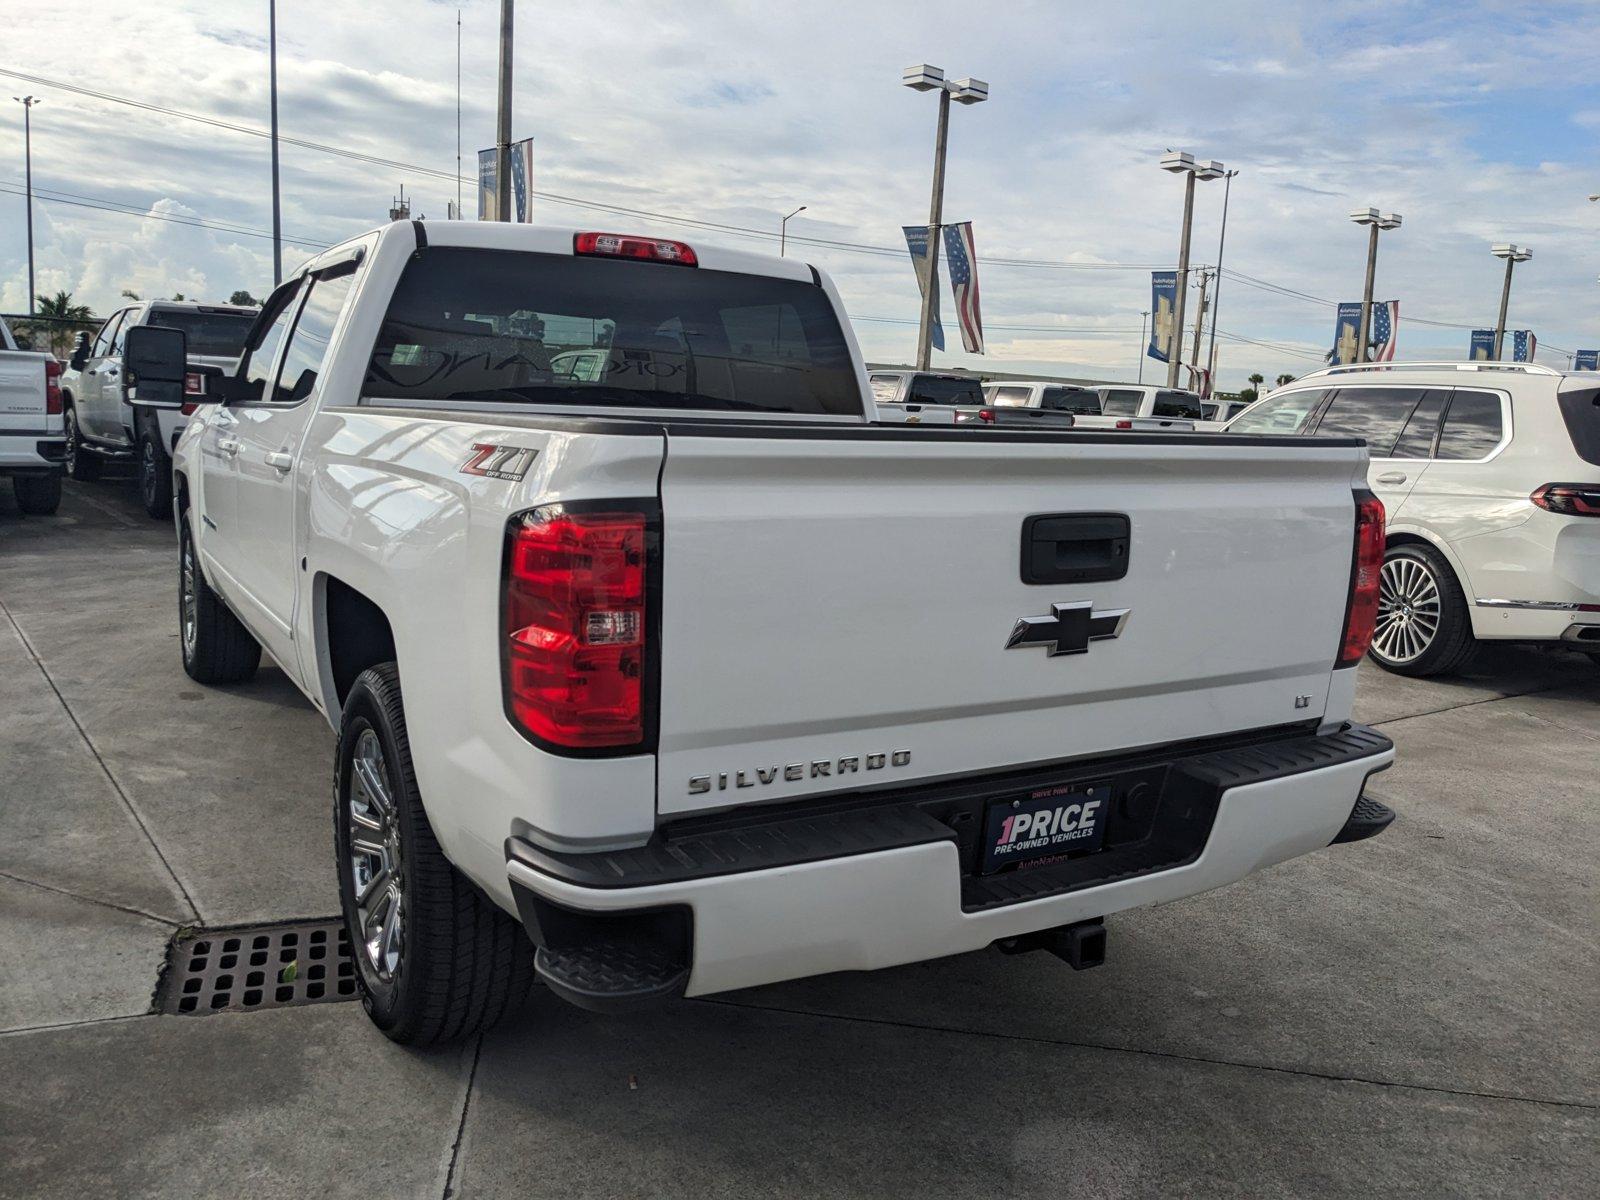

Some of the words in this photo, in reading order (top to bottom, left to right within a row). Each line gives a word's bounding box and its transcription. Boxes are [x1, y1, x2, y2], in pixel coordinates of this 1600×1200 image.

[459, 443, 540, 476] Z71
[500, 472, 522, 481] ROAD
[1295, 695, 1312, 708] LT
[688, 748, 912, 794] SILVERADO
[994, 837, 1050, 855] PRE-OWNED
[1051, 828, 1093, 844] VEHICLES
[1018, 854, 1069, 870] AutoNation
